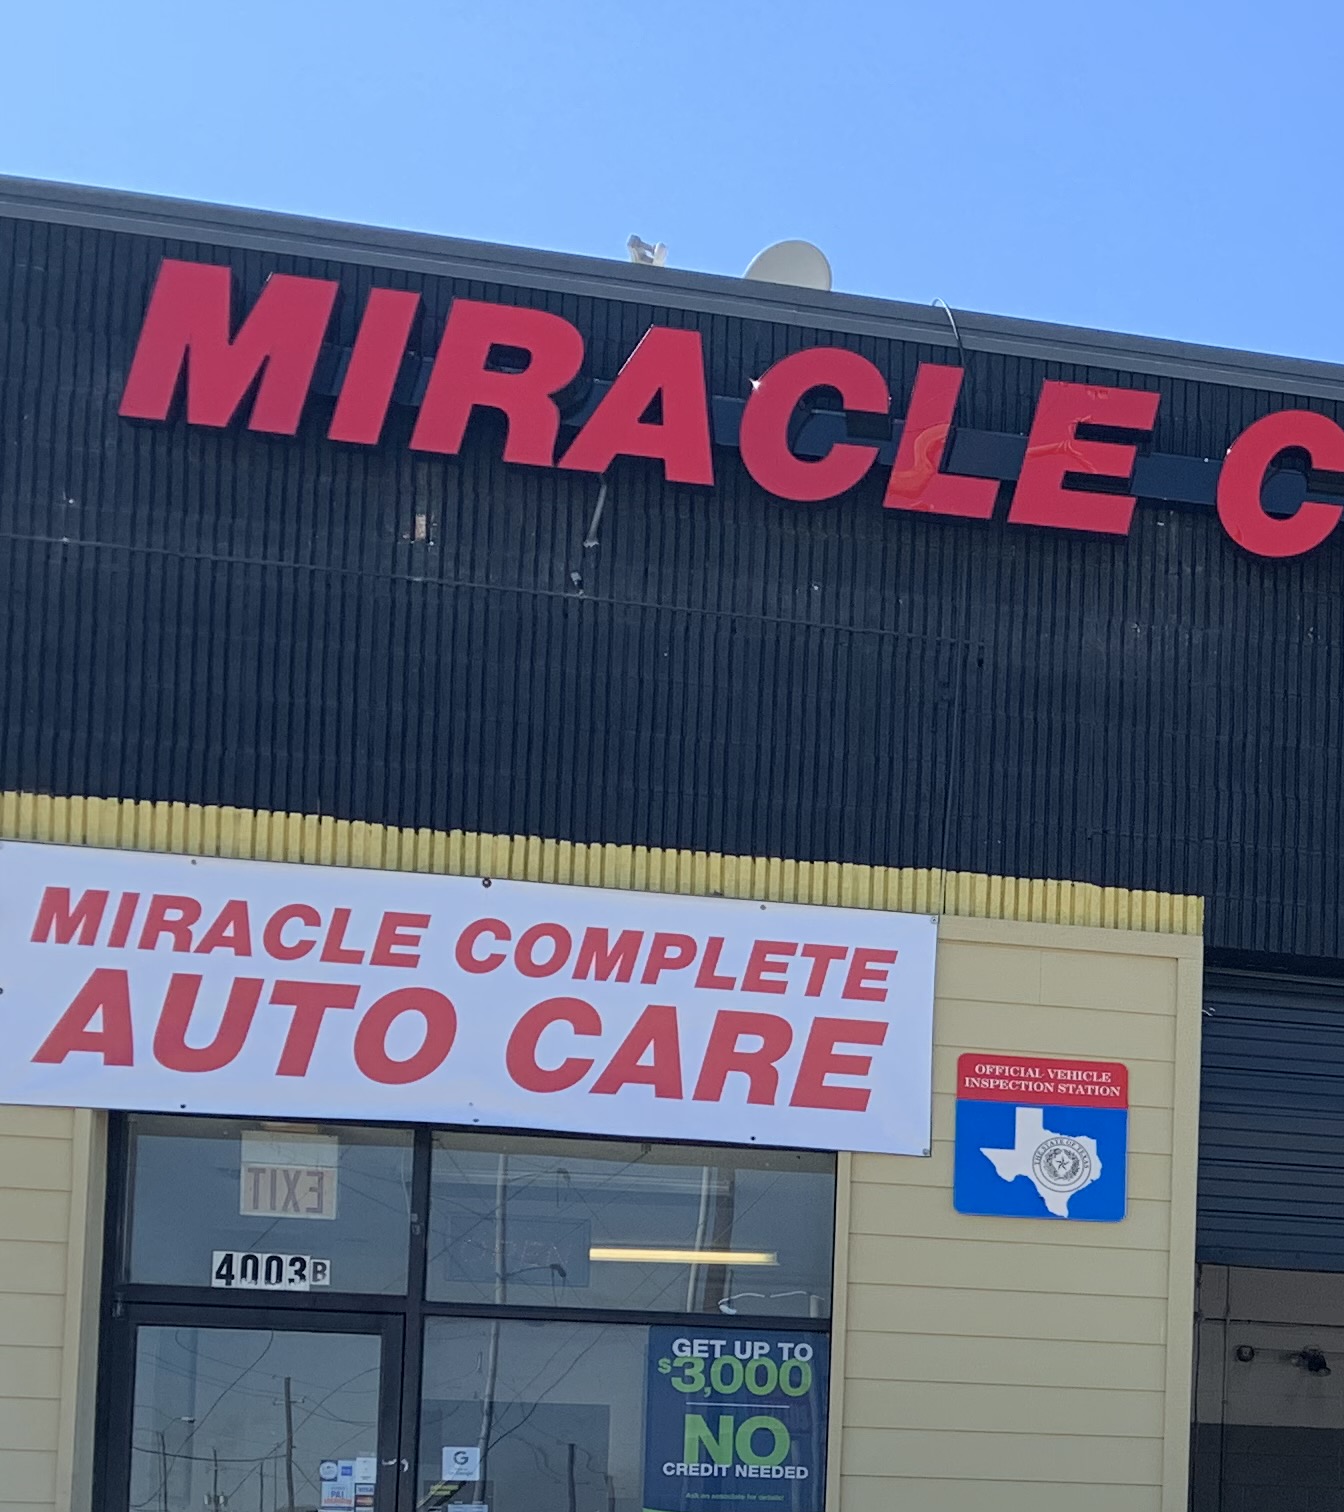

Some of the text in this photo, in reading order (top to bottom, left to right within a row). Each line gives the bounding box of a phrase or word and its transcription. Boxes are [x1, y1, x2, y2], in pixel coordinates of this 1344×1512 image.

[118, 258, 1160, 535] MIRACLE
[29, 885, 898, 1003] MIRACLE COMPLETE
[32, 969, 891, 1113] AUTO CARE
[965, 1077, 1120, 1097] INSPECTION STATION
[975, 1064, 1111, 1083] OFFICIAL VEHICLE
[1041, 1140, 1063, 1152] STATE
[1076, 1146, 1089, 1169] TEXAS
[672, 1338, 813, 1362] GET UP TO
[658, 1355, 813, 1398] $3,000
[684, 1413, 791, 1468] NO
[662, 1462, 809, 1480] CREDIT NEEDED
